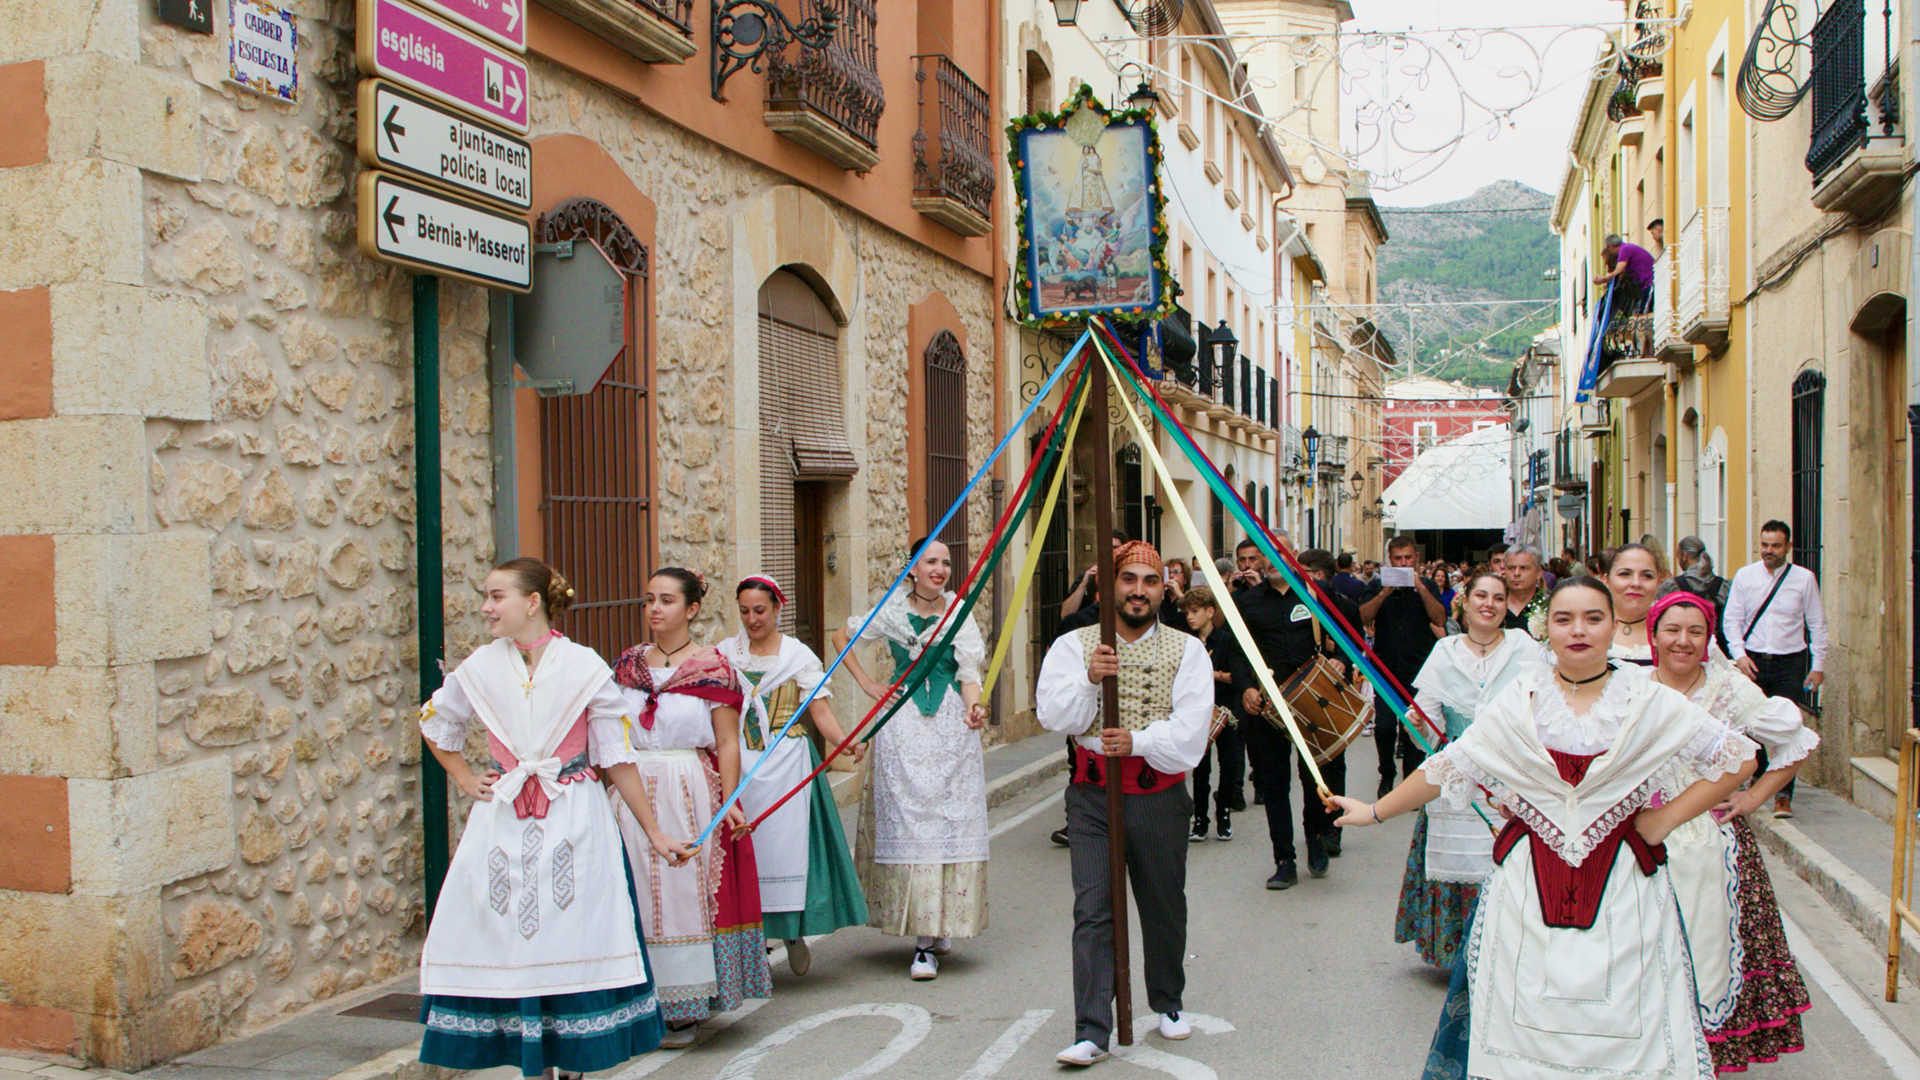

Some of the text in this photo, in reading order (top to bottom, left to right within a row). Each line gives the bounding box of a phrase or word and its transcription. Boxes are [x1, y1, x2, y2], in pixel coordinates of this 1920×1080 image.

[244, 12, 283, 42] CARRER
[381, 27, 446, 72] església
[449, 122, 527, 169] ajuntament
[495, 167, 528, 199] local
